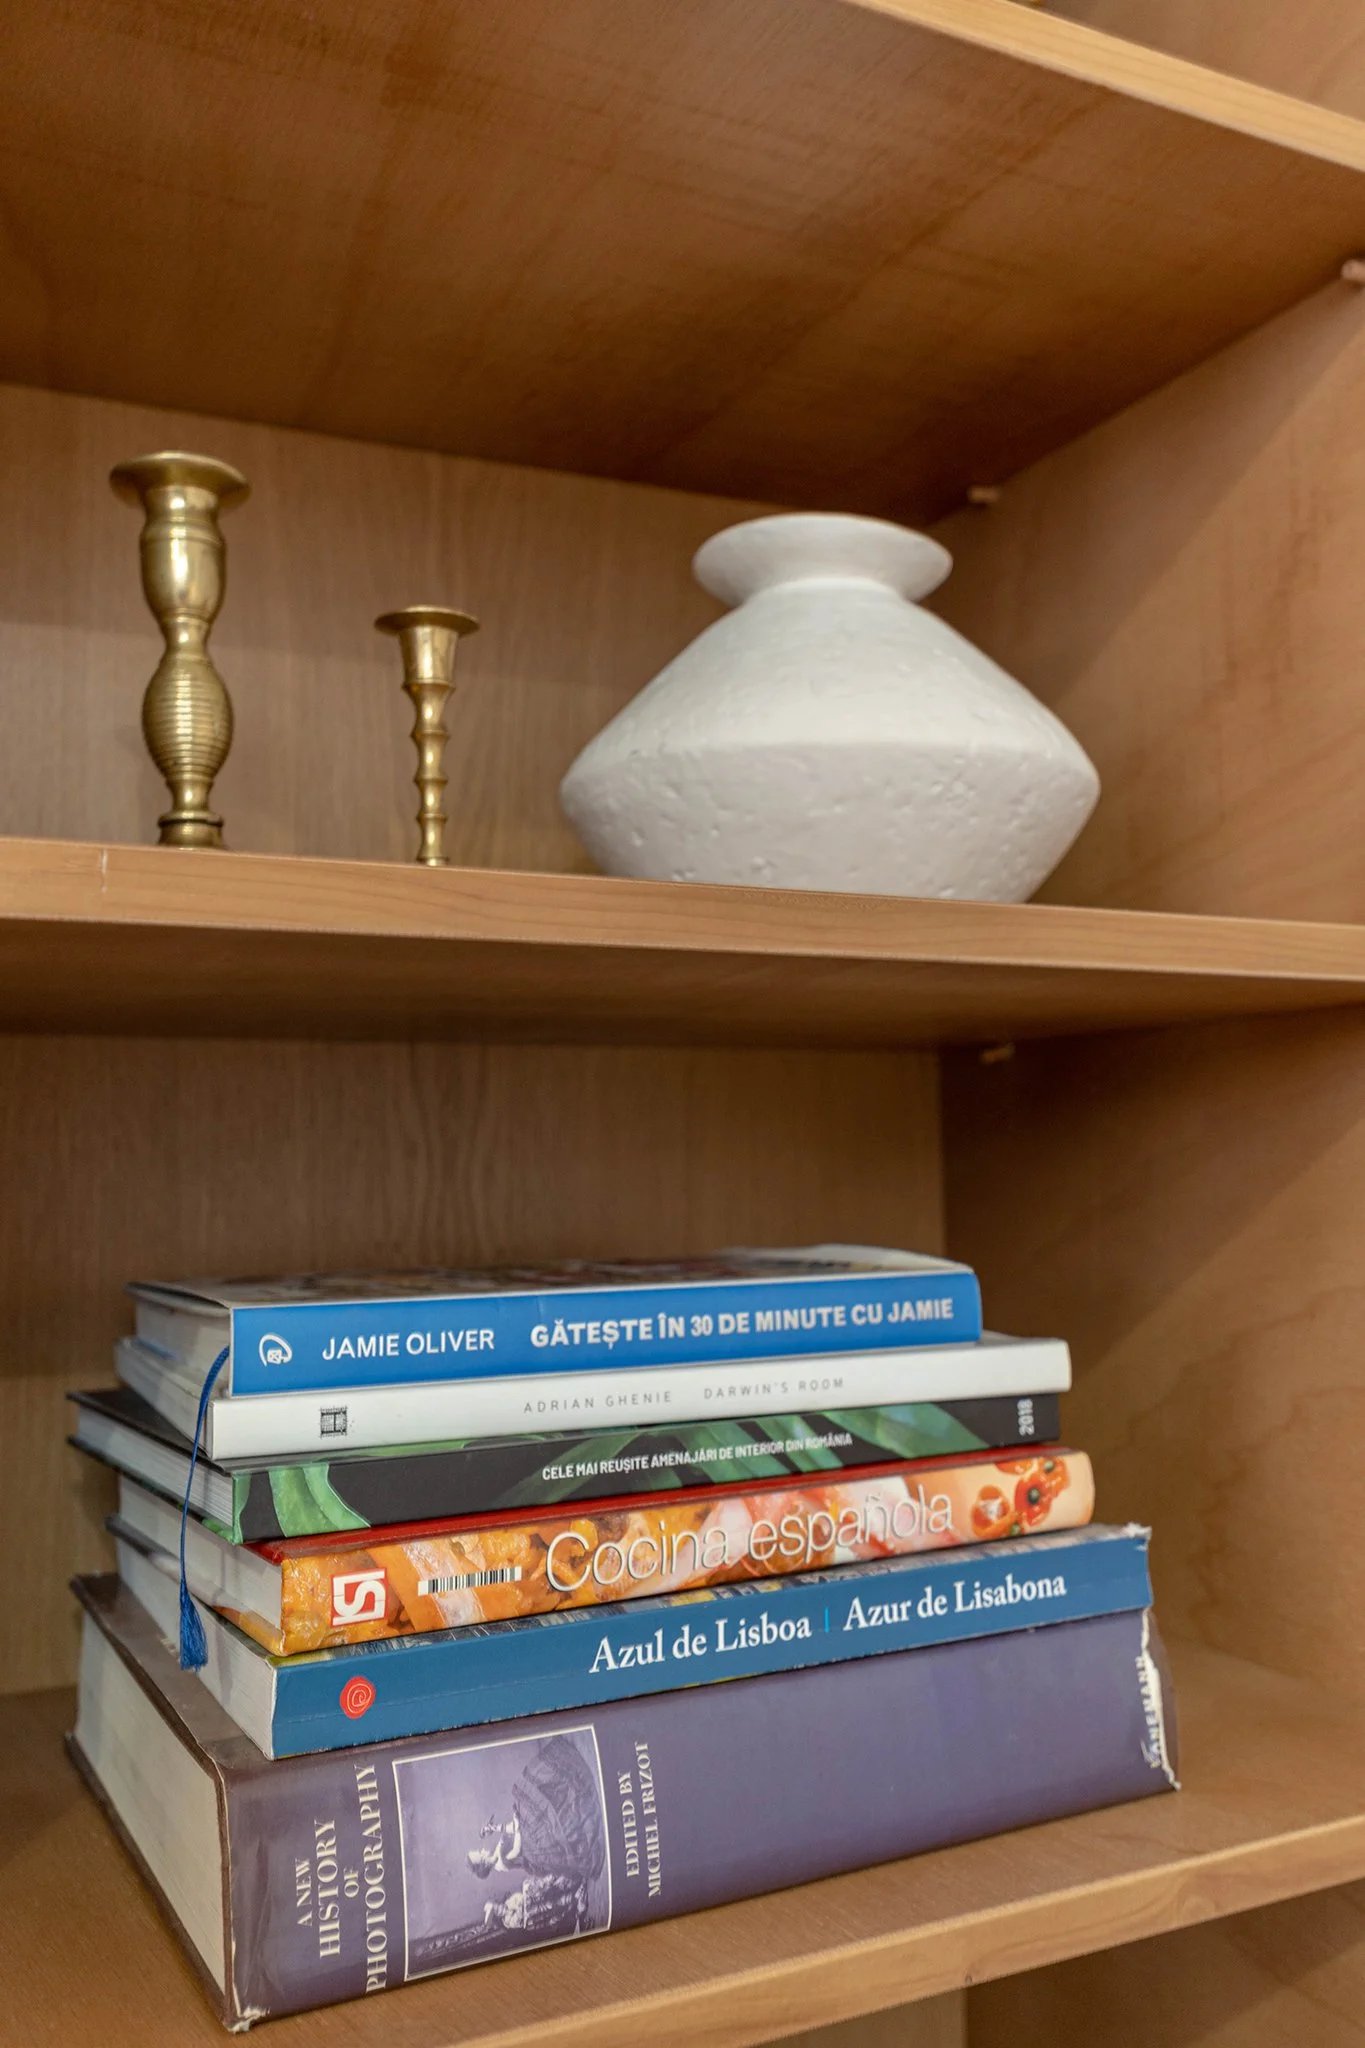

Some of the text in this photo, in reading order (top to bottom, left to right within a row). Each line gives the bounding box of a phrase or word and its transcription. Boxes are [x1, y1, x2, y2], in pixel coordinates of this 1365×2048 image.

[322, 1329, 496, 1360] JAMIE OLIVER
[658, 1312, 685, 1339] ÎN
[690, 1313, 715, 1337] 30
[718, 1312, 751, 1335] DE
[755, 1305, 847, 1333] MINUTE
[850, 1302, 884, 1326] CU
[887, 1298, 954, 1322] JAMIE
[523, 1390, 673, 1414] ADRIAN GHENIE
[704, 1377, 845, 1400] DARWIN'S ROOM
[542, 1462, 574, 1481] CELE
[576, 1458, 599, 1477] MAI
[718, 1444, 735, 1461] DE
[735, 1438, 786, 1459] INTERIOR
[785, 1437, 805, 1452] DIN
[545, 1484, 954, 1593] Cocina española
[843, 1571, 1068, 1632] Azur de Lisabona
[588, 1609, 813, 1675] Azul de Lisboa
[617, 1770, 640, 1878] EDITED BY
[634, 1739, 662, 1899] MICHEL FRIZOT
[295, 1857, 313, 1927] A NEW
[314, 1818, 341, 1960] HISTORY
[343, 1865, 360, 1898] OF
[353, 1763, 389, 1995] PHOTOGRAPHY
